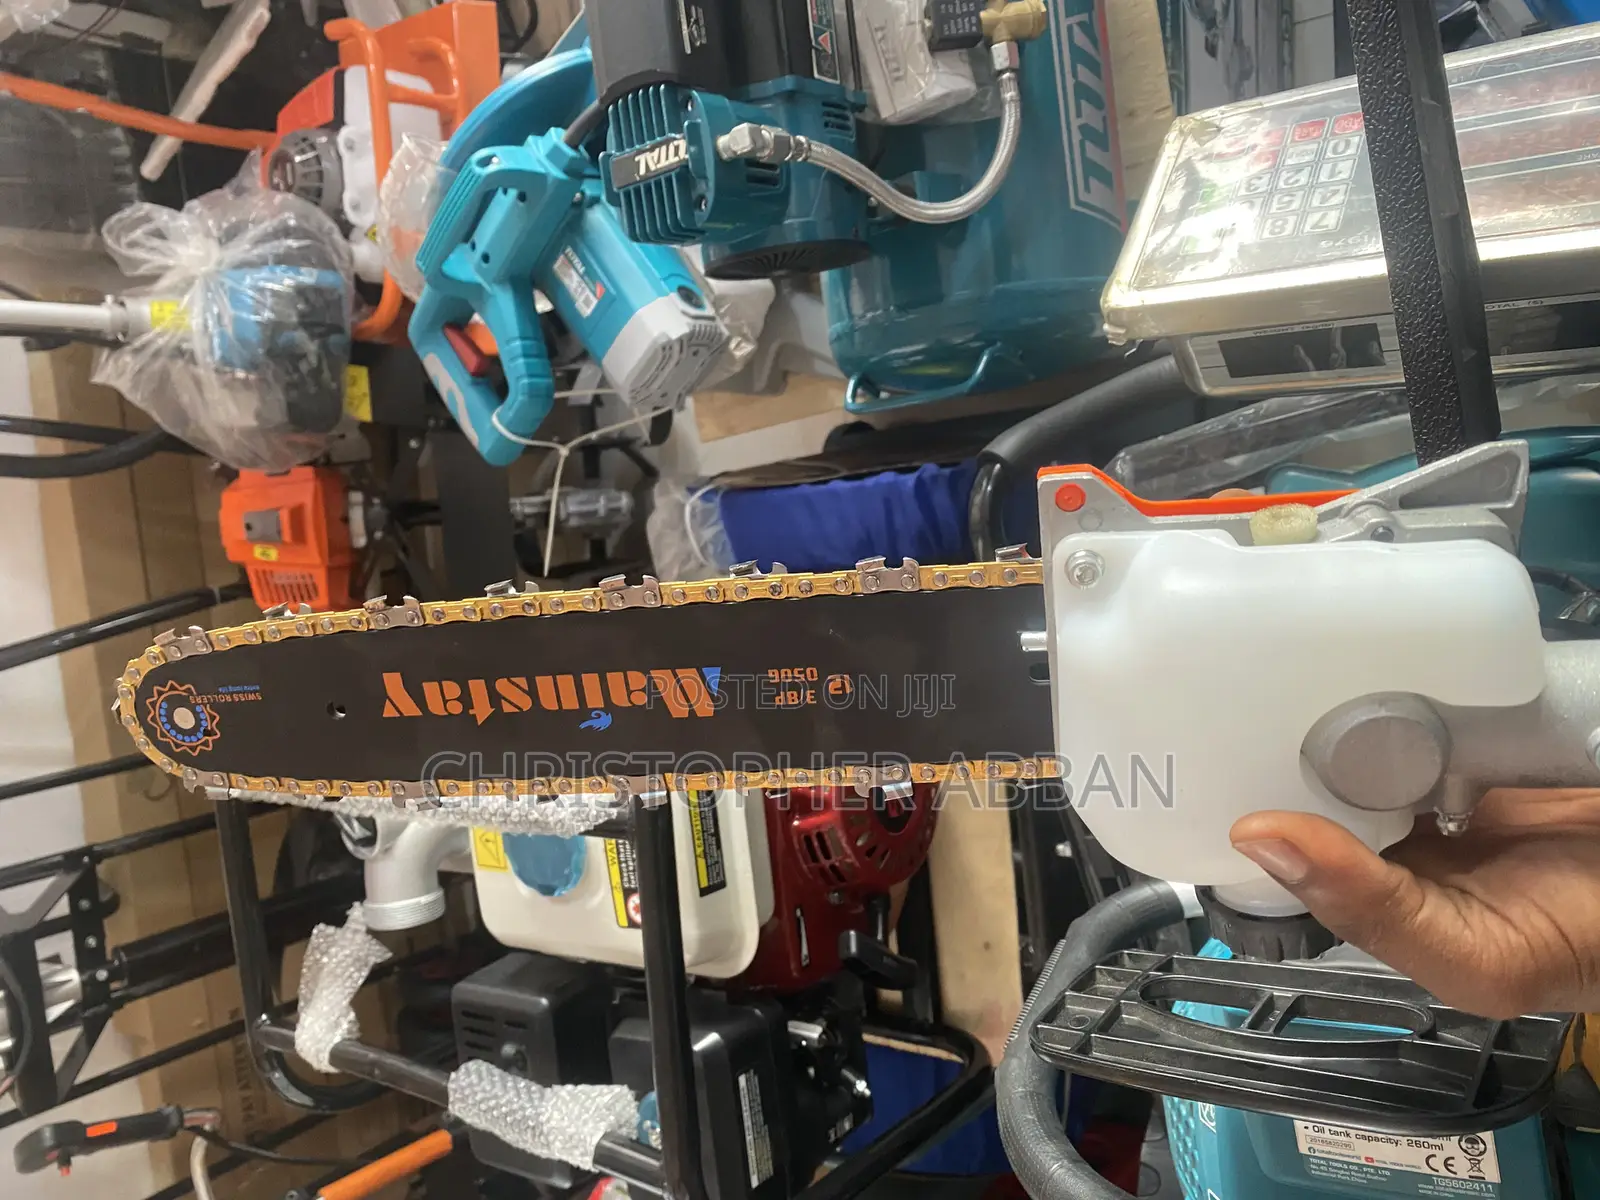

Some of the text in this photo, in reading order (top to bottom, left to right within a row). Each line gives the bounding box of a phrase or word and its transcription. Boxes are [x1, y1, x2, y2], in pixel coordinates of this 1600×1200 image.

[1332, 138, 1351, 156] 0
[634, 139, 689, 176] OTAL
[1245, 162, 1344, 193] 1 2 3
[1275, 194, 1296, 211] 5
[1318, 187, 1340, 205] 4
[1269, 212, 1329, 235] 7 8
[1485, 302, 1522, 310] OTAL
[189, 692, 262, 704] SWISS ROLLERS
[381, 667, 721, 726] Mainstay
[1312, 1125, 1444, 1151] Oil tank capacity: 260ml
[1309, 1158, 1328, 1166] TOTAL
[1329, 1161, 1348, 1169] TOOLS
[1431, 1177, 1494, 1193] TG5602411
